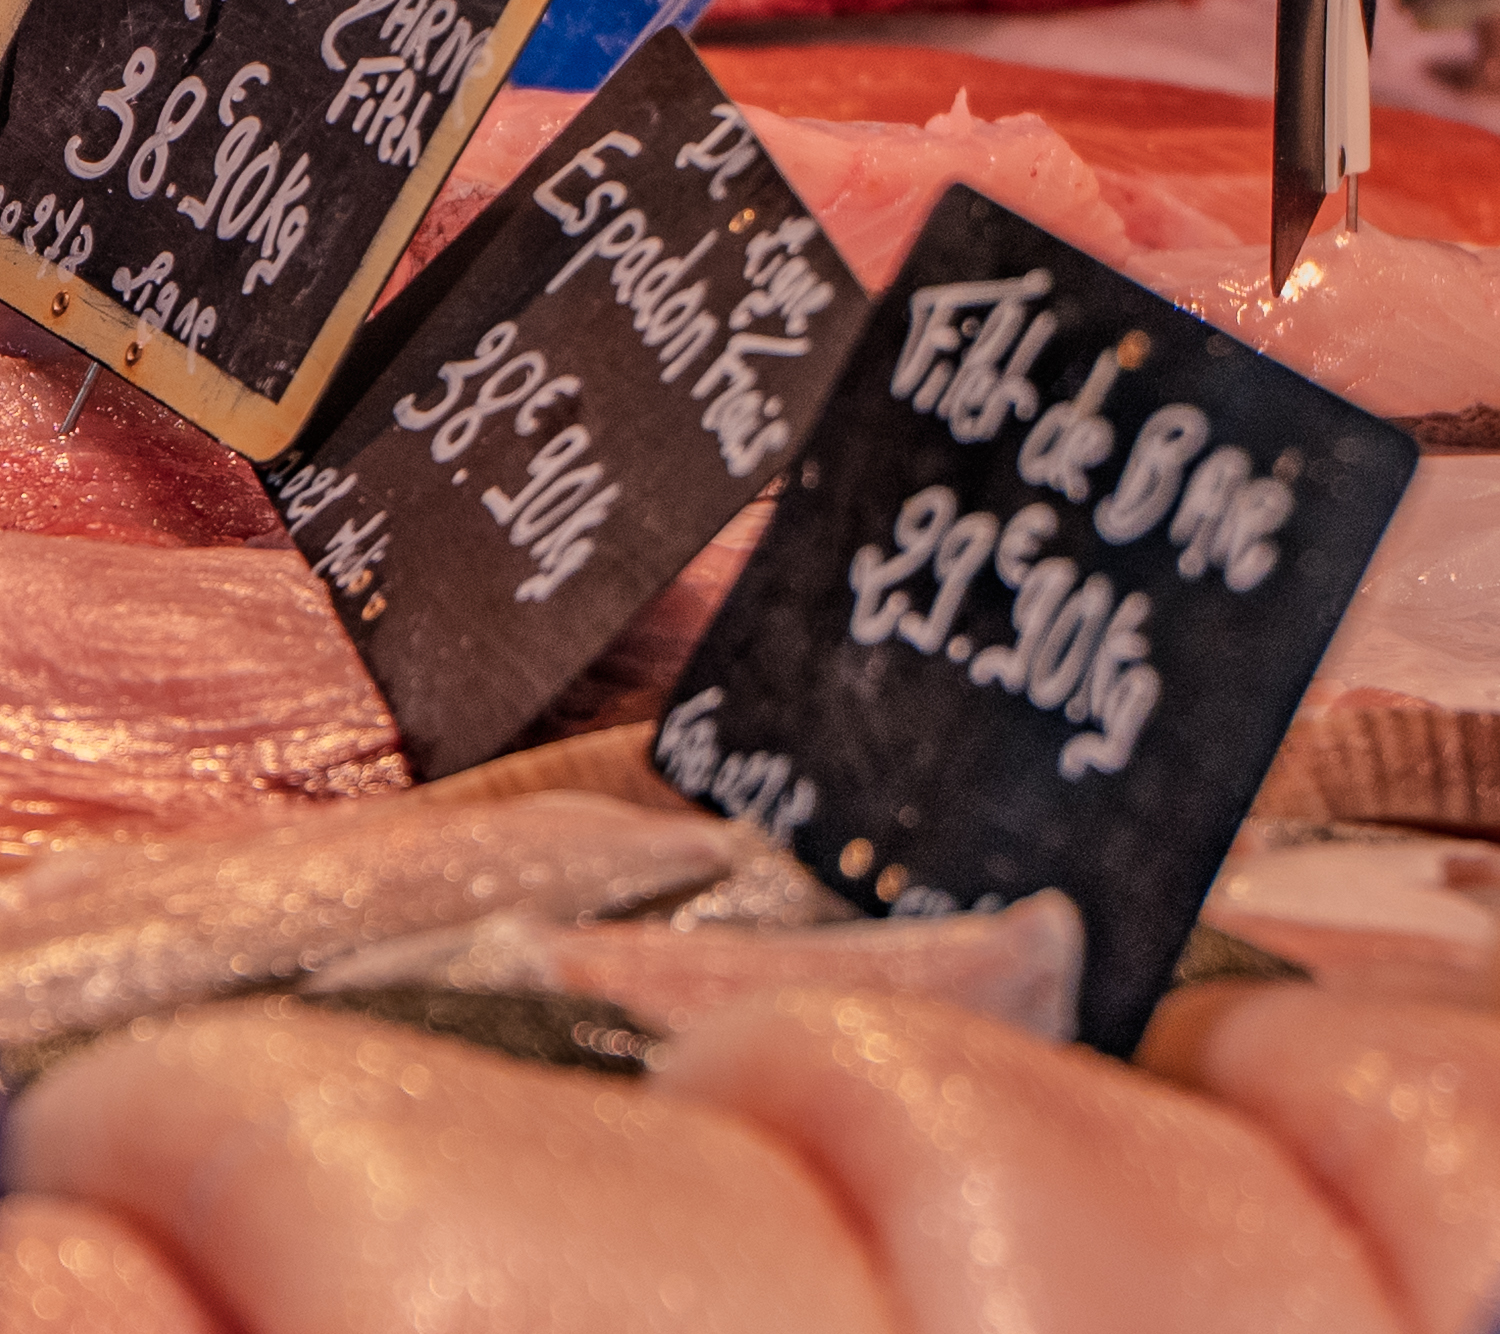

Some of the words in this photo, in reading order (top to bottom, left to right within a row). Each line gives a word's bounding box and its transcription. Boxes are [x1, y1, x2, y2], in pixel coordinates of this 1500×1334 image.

[675, 103, 758, 199] De
[533, 131, 719, 384] Espadon
[691, 331, 810, 477] Frais
[1017, 346, 1116, 503] de
[1093, 403, 1297, 594] BAR
